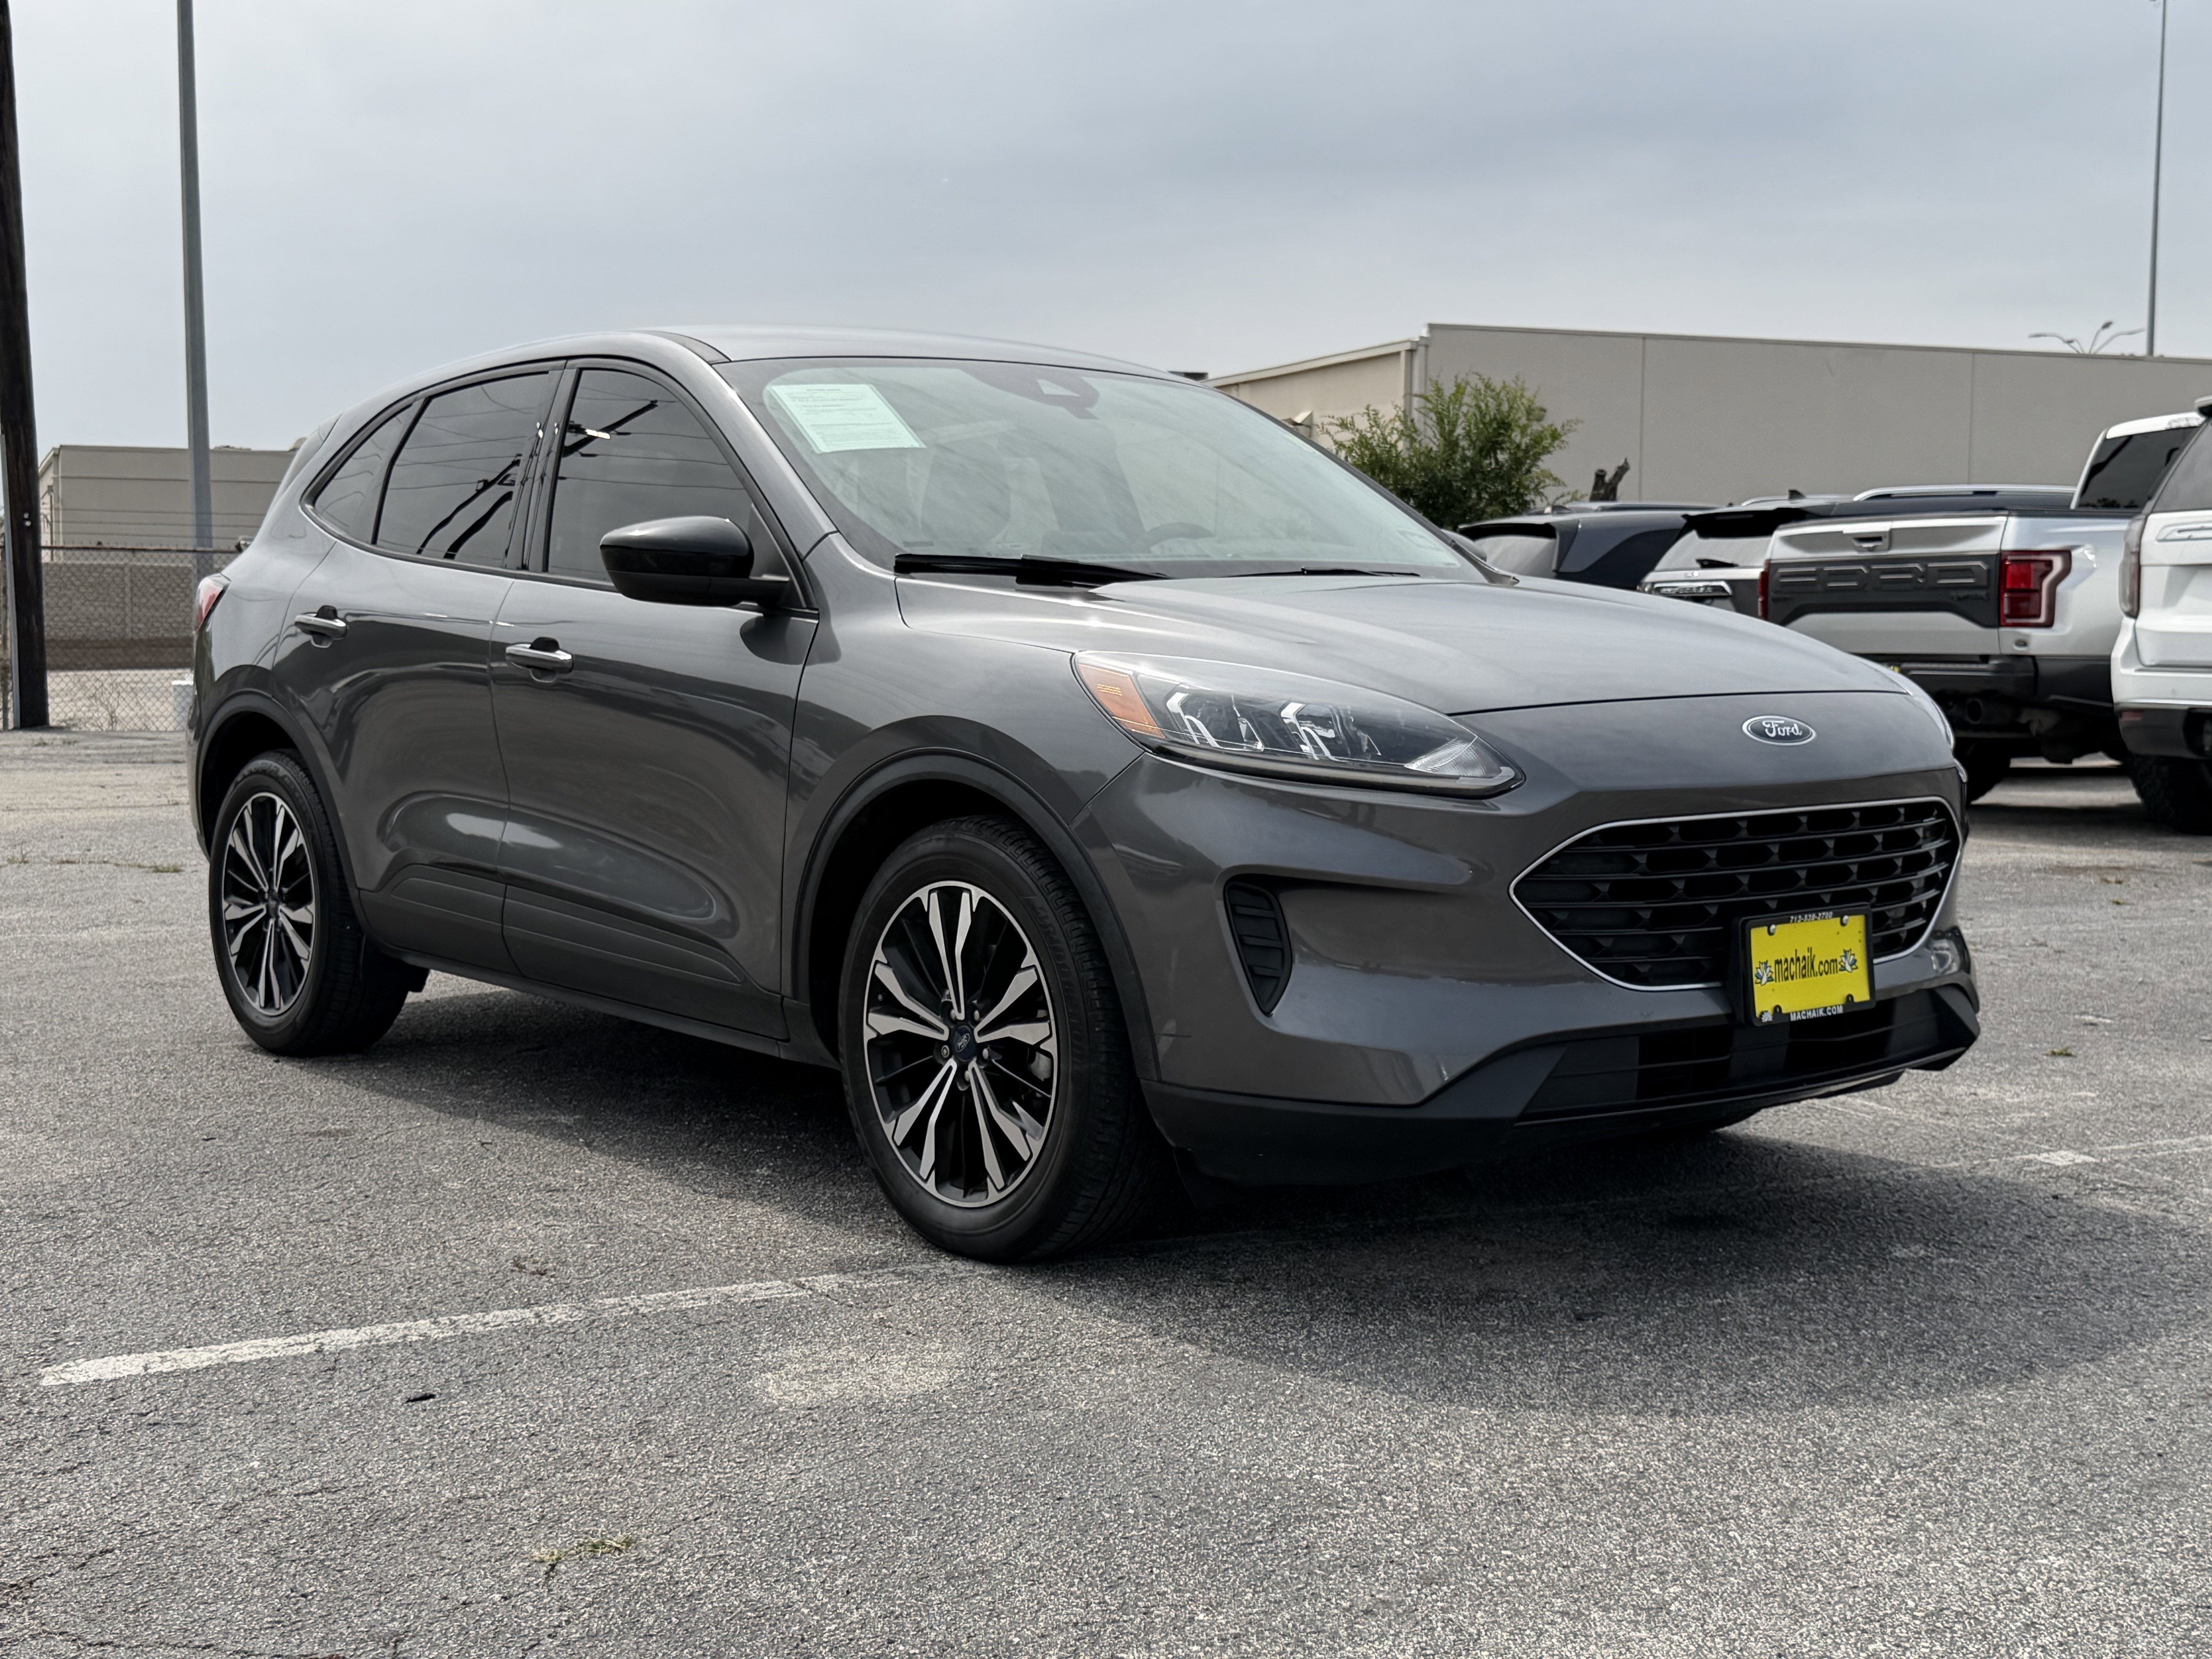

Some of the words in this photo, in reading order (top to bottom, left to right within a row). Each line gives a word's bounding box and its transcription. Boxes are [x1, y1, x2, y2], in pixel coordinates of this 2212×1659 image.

[1775, 562, 1990, 591] FORD
[1762, 720, 1802, 737] Ford
[1774, 947, 1838, 982] machaik.com
[1790, 1005, 1843, 1021] MACHAIK.COM
